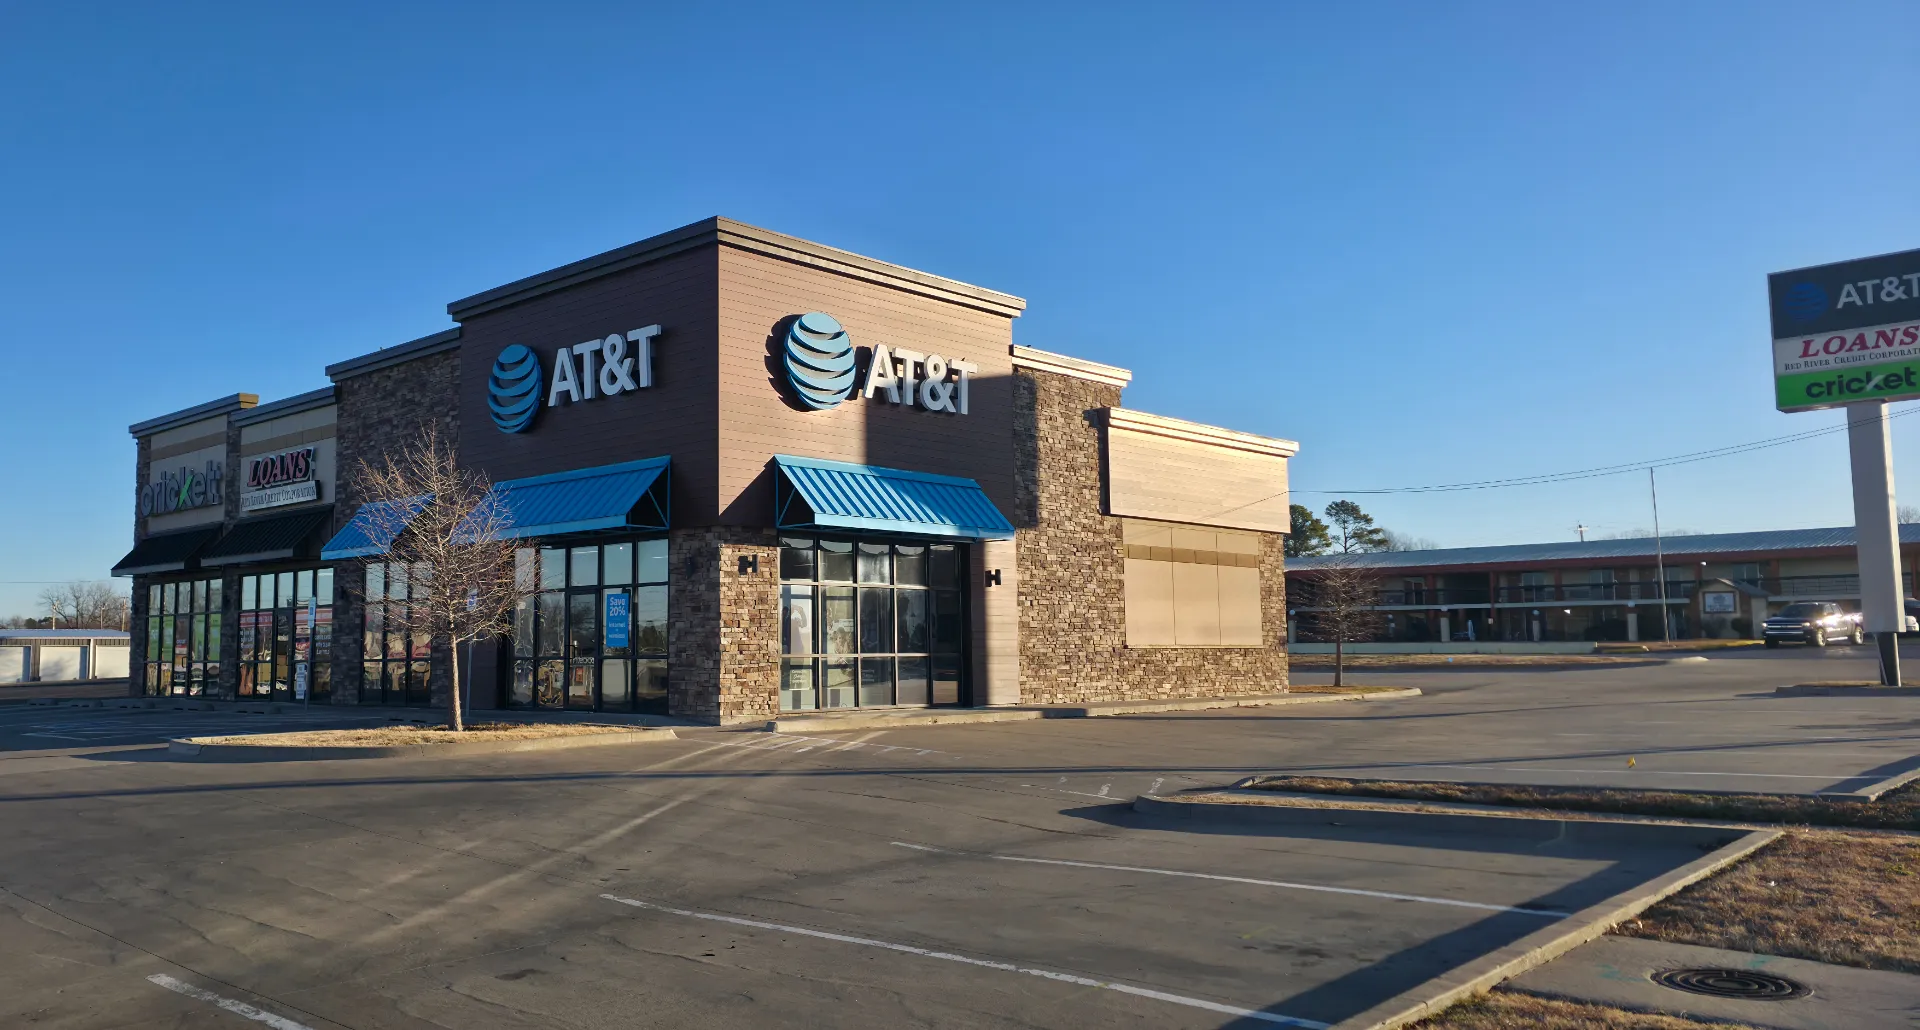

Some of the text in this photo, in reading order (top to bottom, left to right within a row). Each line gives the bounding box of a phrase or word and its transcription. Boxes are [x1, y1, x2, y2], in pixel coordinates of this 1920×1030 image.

[1836, 272, 1920, 309] AT&T
[1798, 325, 1920, 358] LOANS
[548, 324, 661, 407] AT&T
[863, 344, 978, 415] AT&T
[1784, 362, 1802, 371] RED
[1804, 359, 1830, 368] RIVER
[1834, 354, 1866, 364] CREDIT
[1805, 367, 1917, 398] cricket
[247, 449, 312, 487] LOANS
[140, 460, 222, 517] cricket
[610, 597, 625, 605] Save
[610, 606, 626, 616] 20%
